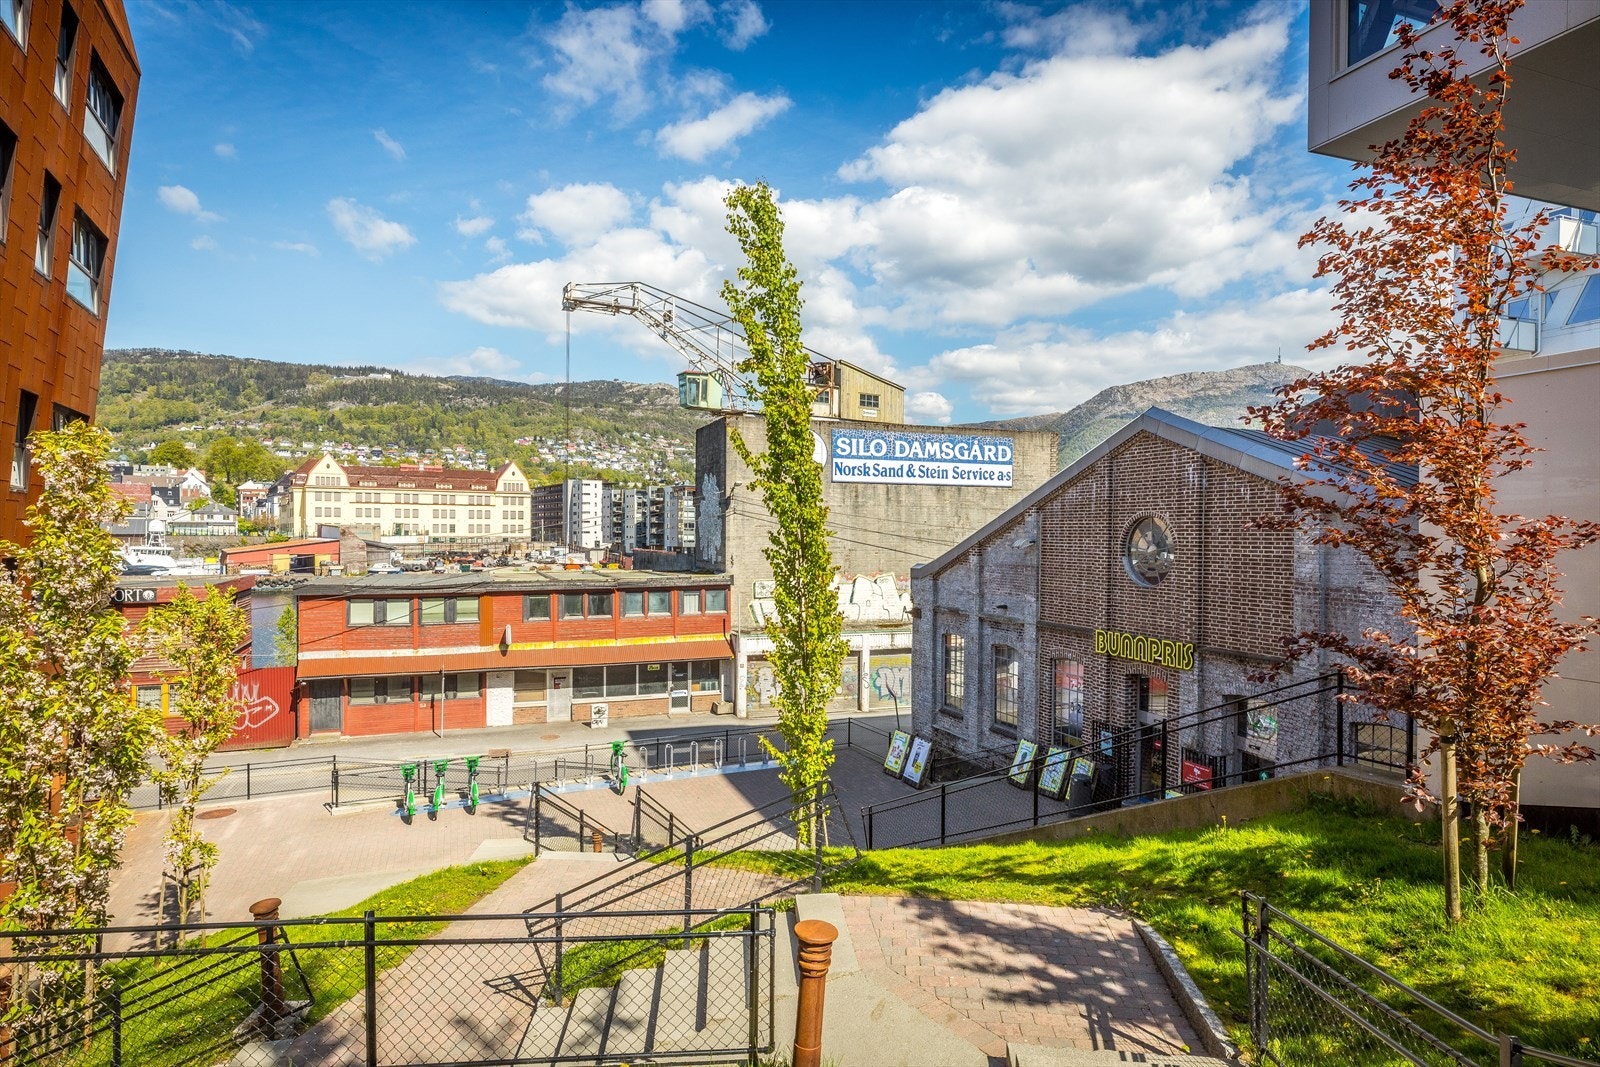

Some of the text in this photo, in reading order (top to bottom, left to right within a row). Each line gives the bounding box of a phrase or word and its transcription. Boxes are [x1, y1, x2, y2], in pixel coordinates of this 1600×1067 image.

[836, 437, 1012, 462] SILO DAMSGÅRD
[834, 461, 871, 477] Norsk
[872, 462, 904, 478] Sand
[906, 463, 917, 478] &
[918, 465, 949, 479] Stein
[952, 466, 995, 481] Service
[114, 589, 143, 602] ORT
[1095, 629, 1194, 670] BUNNPRIS
